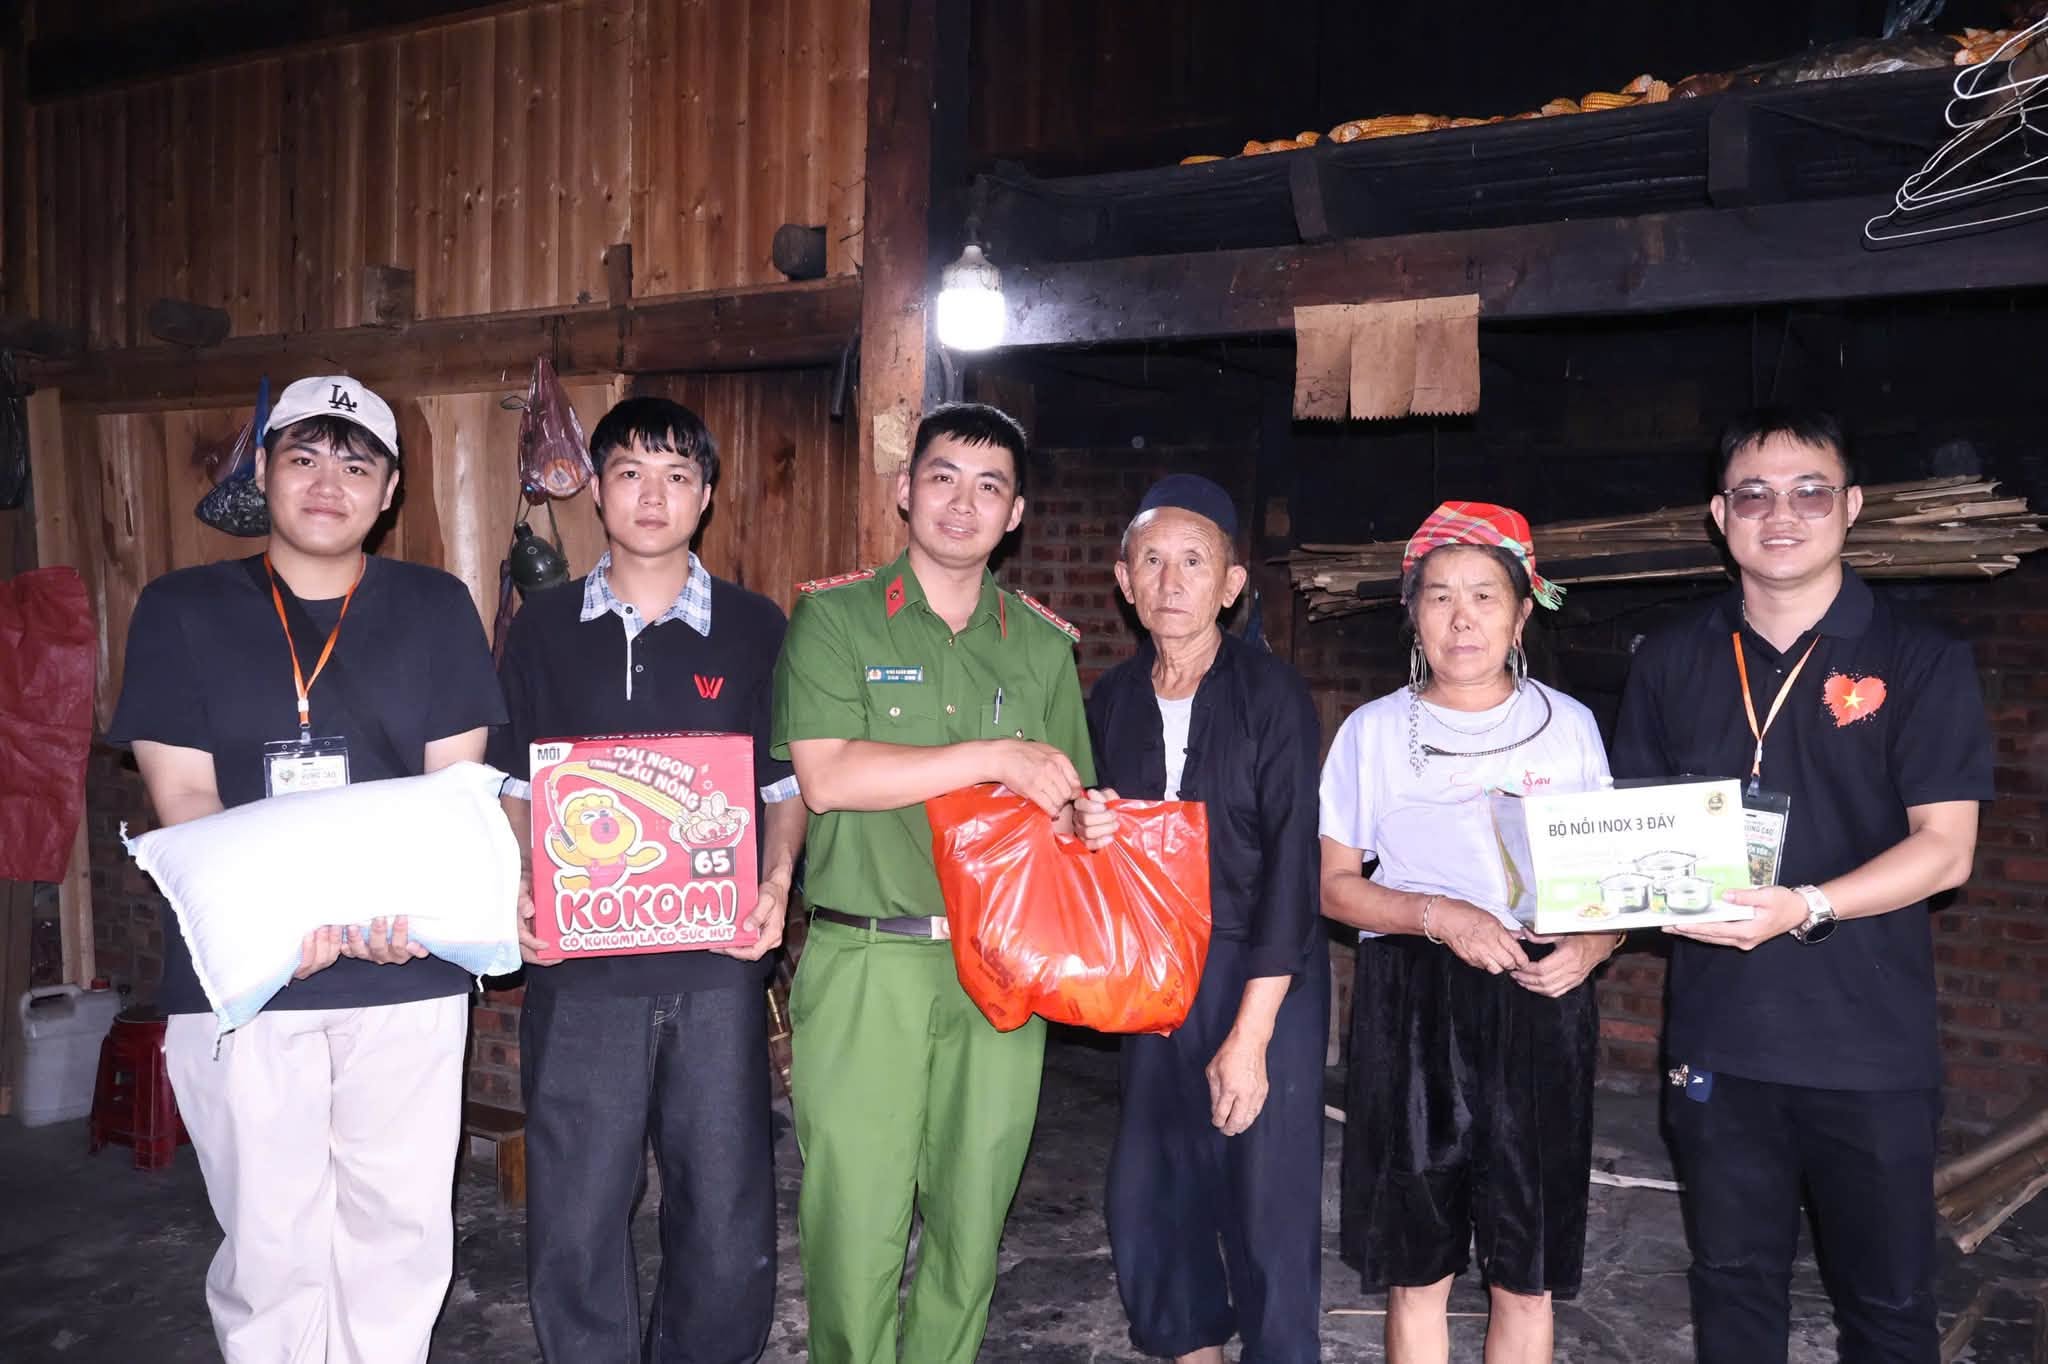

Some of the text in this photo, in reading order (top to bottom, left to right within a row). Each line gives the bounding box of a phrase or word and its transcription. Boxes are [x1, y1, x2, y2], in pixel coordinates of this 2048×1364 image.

[328, 384, 358, 413] LA
[646, 751, 695, 785] NGON
[654, 774, 700, 809] NÓNG
[1548, 813, 1676, 838] BỘ NỒI INOX 3 ĐÁY
[694, 849, 730, 874] 65
[557, 882, 735, 932] KOKOMI
[584, 933, 634, 947] KOKOMI
